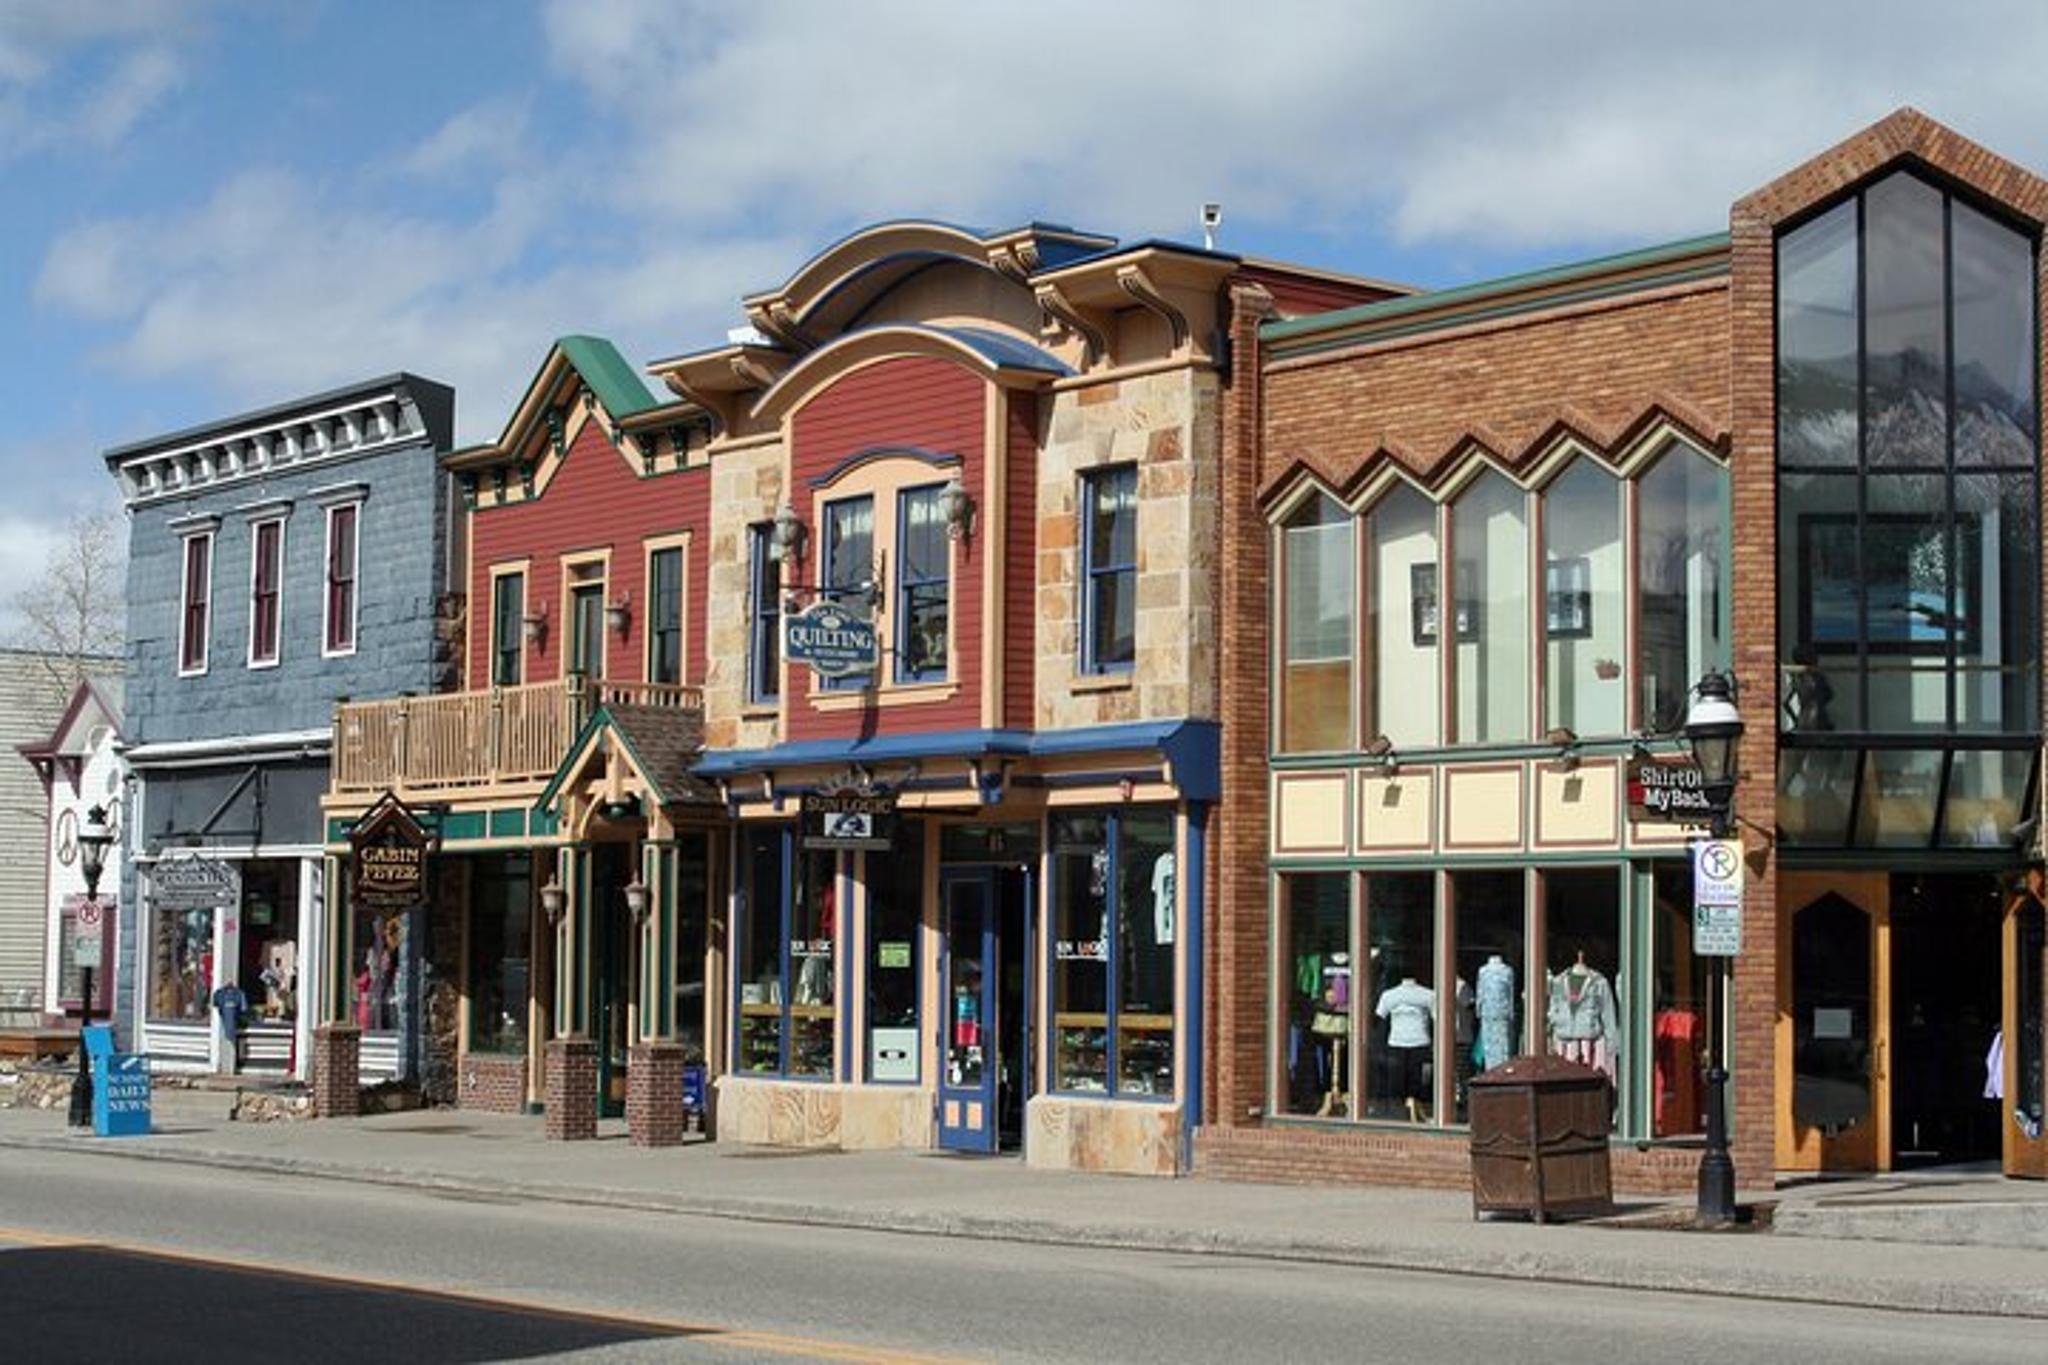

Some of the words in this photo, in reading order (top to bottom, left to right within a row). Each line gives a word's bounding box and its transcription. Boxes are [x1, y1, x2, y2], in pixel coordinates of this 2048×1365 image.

[789, 627, 872, 650] QUILTING
[1640, 767, 1684, 786] Shirt
[806, 796, 840, 812] SUN
[842, 797, 891, 815] LOGIC
[1644, 788, 1671, 811] My
[1672, 790, 1710, 808] Back
[361, 847, 419, 863] CABIN
[108, 1085, 148, 1098] DAILY
[109, 1100, 151, 1112] NEWS
